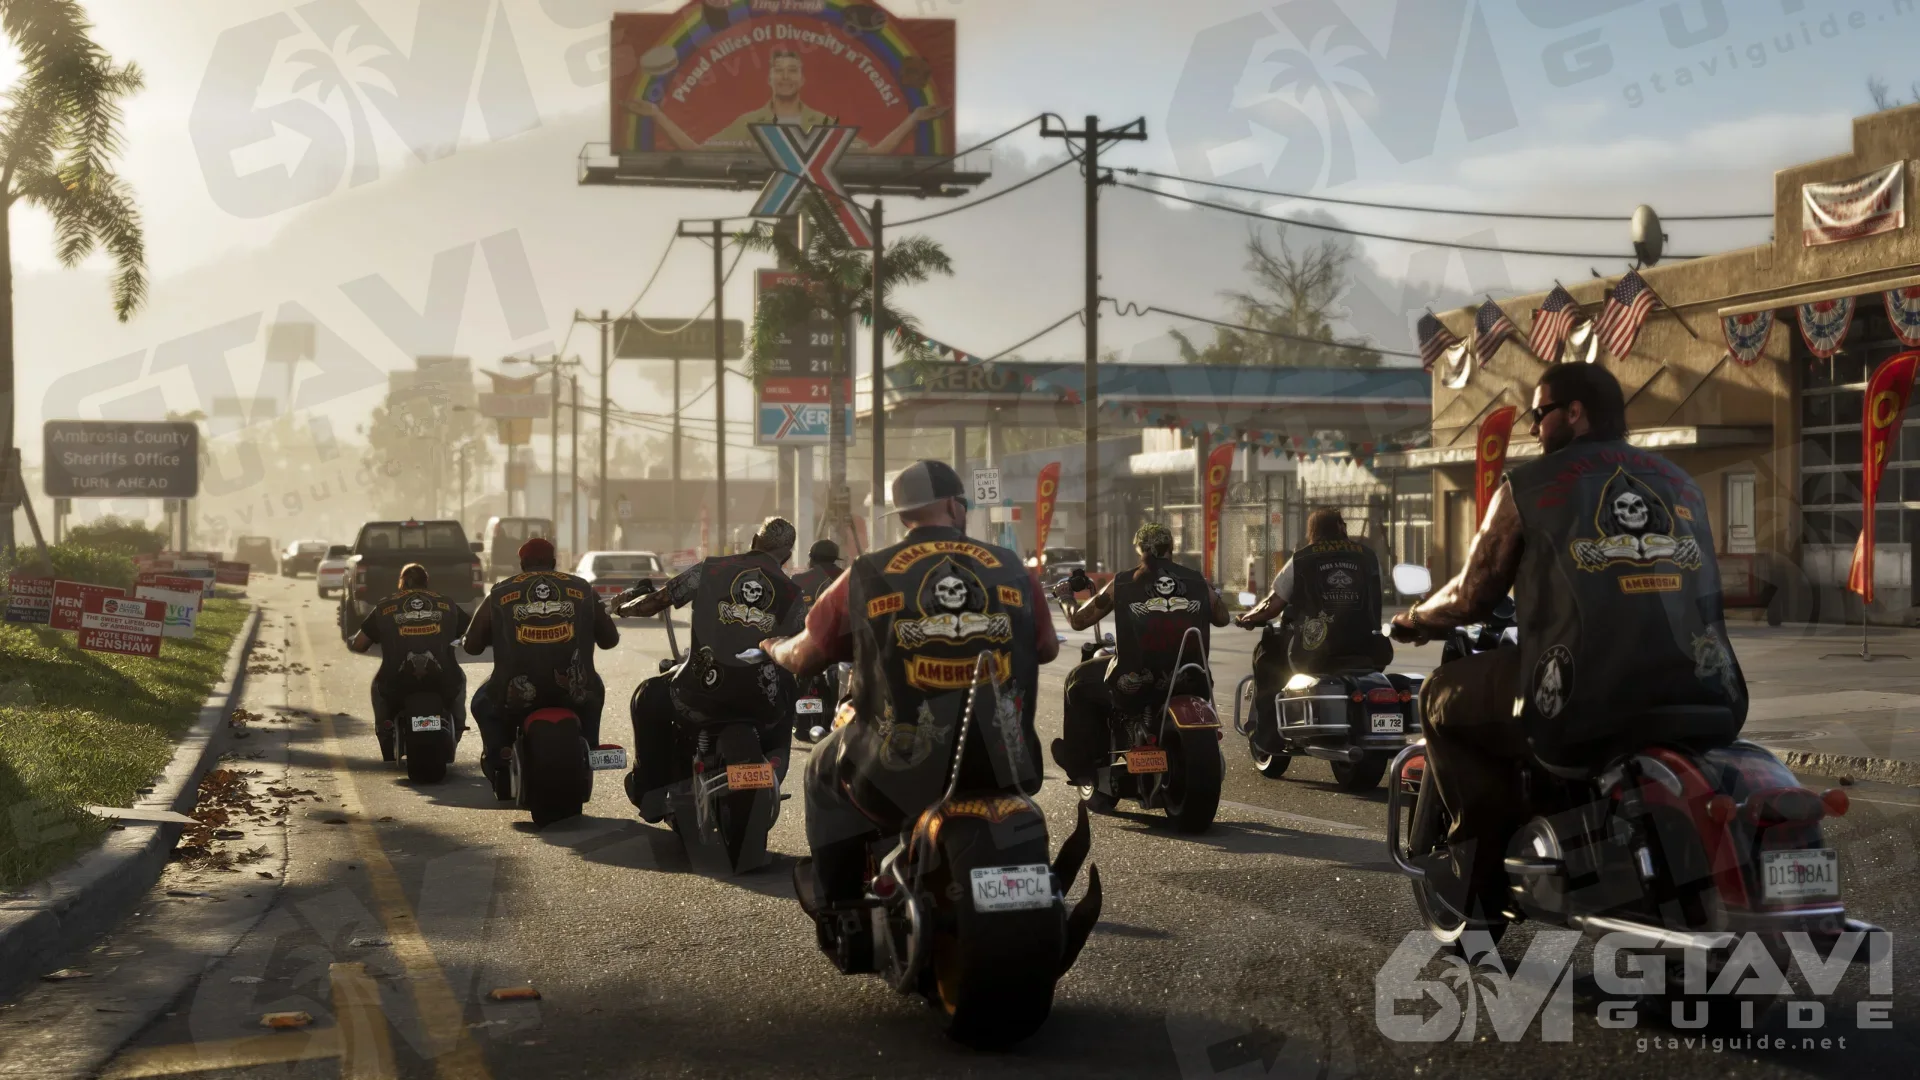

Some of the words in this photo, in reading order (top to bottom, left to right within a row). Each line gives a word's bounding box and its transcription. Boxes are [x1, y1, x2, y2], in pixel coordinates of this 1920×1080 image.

[672, 59, 711, 102] Proud
[710, 35, 751, 63] Allies
[753, 24, 772, 42] Of
[53, 430, 128, 444] Ambrosia
[133, 430, 190, 447] County
[63, 451, 127, 466] Sheriffs
[134, 452, 180, 466] Office
[72, 477, 110, 488] TURN
[117, 477, 168, 489] AHEAD
[977, 486, 997, 500] 35
[891, 545, 931, 570] FINAL
[933, 542, 996, 567] CHAPTER
[1625, 577, 1677, 589] AMBROSIA
[11, 584, 53, 596] HENSH
[1001, 588, 1019, 604] MC
[59, 608, 79, 618] FOR
[110, 624, 144, 632] AMBROSIA
[124, 619, 160, 628] LIFEBLOOD
[403, 625, 437, 634] AMBROSIA
[98, 631, 120, 640] VOTE
[122, 634, 143, 642] ERIN
[522, 625, 569, 640] AMBROSIA
[85, 636, 154, 653] HENSHAW
[1389, 718, 1402, 728] 732
[1768, 863, 1833, 886] D15B8A1
